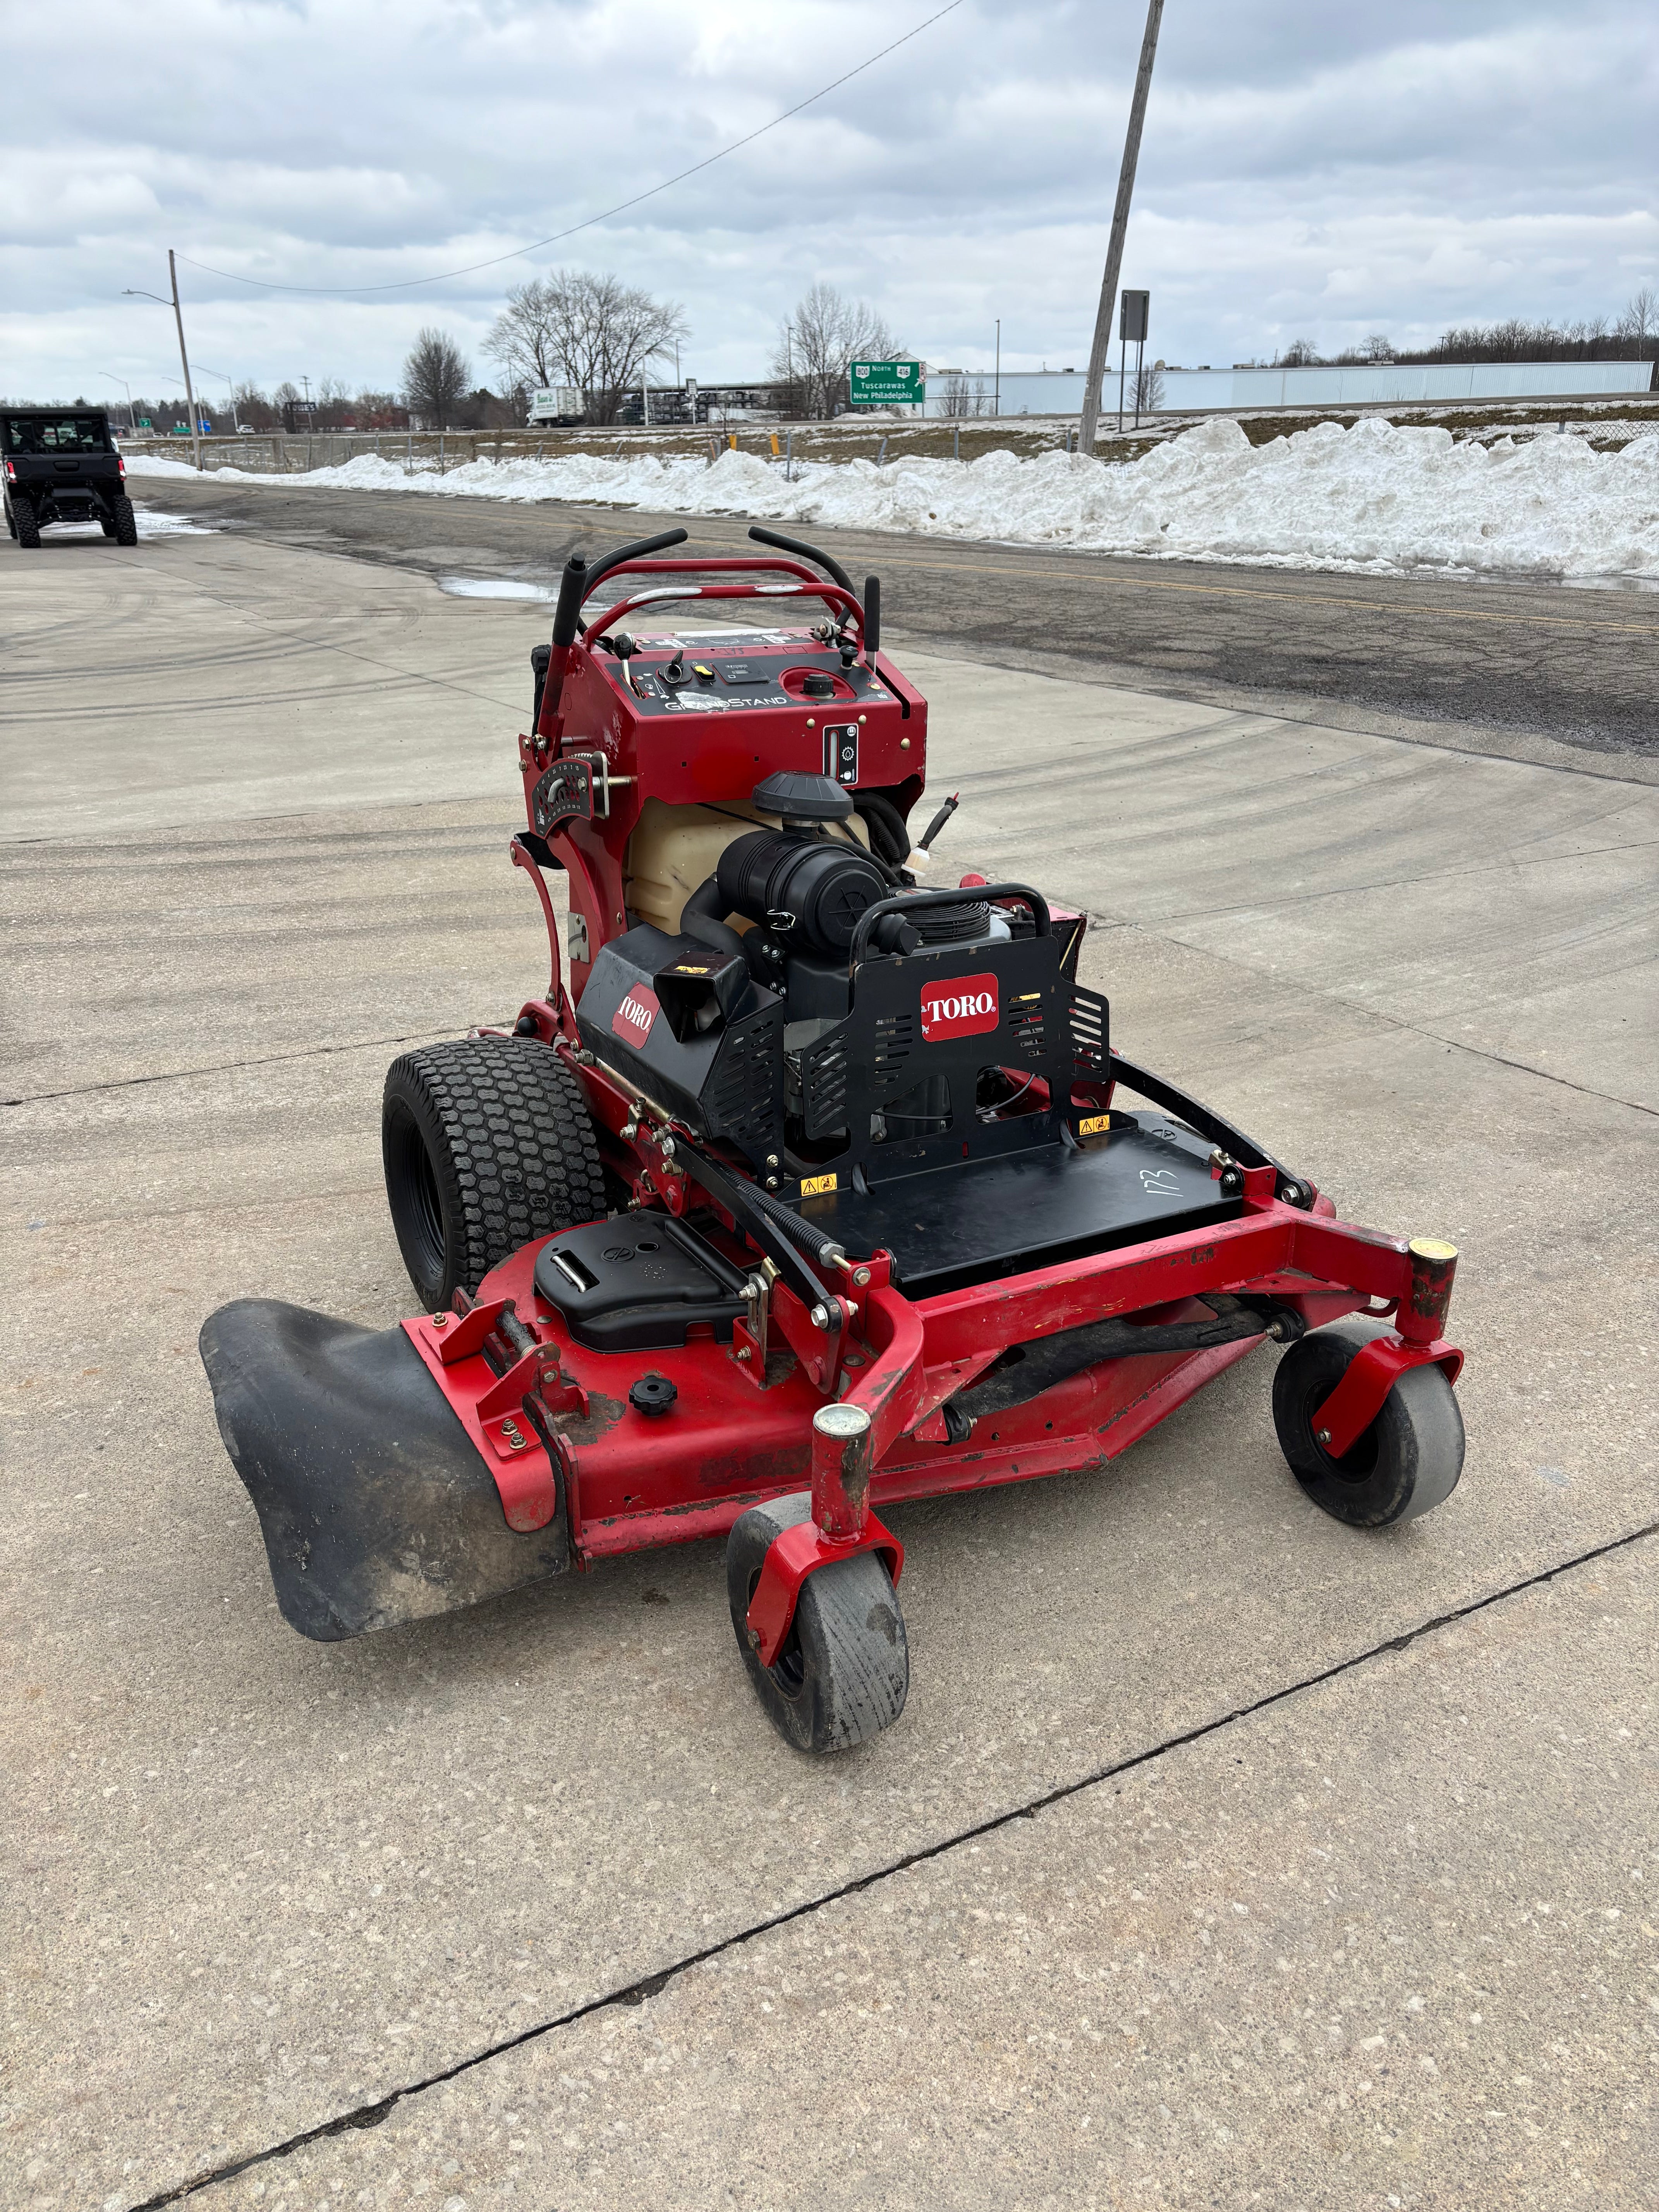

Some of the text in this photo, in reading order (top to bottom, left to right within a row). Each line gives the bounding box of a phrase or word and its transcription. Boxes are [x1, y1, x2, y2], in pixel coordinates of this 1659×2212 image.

[871, 391, 913, 400] Philadelphia
[617, 996, 652, 1030] TORO
[927, 992, 993, 1022] TORO
[1139, 1170, 1184, 1197] 173
